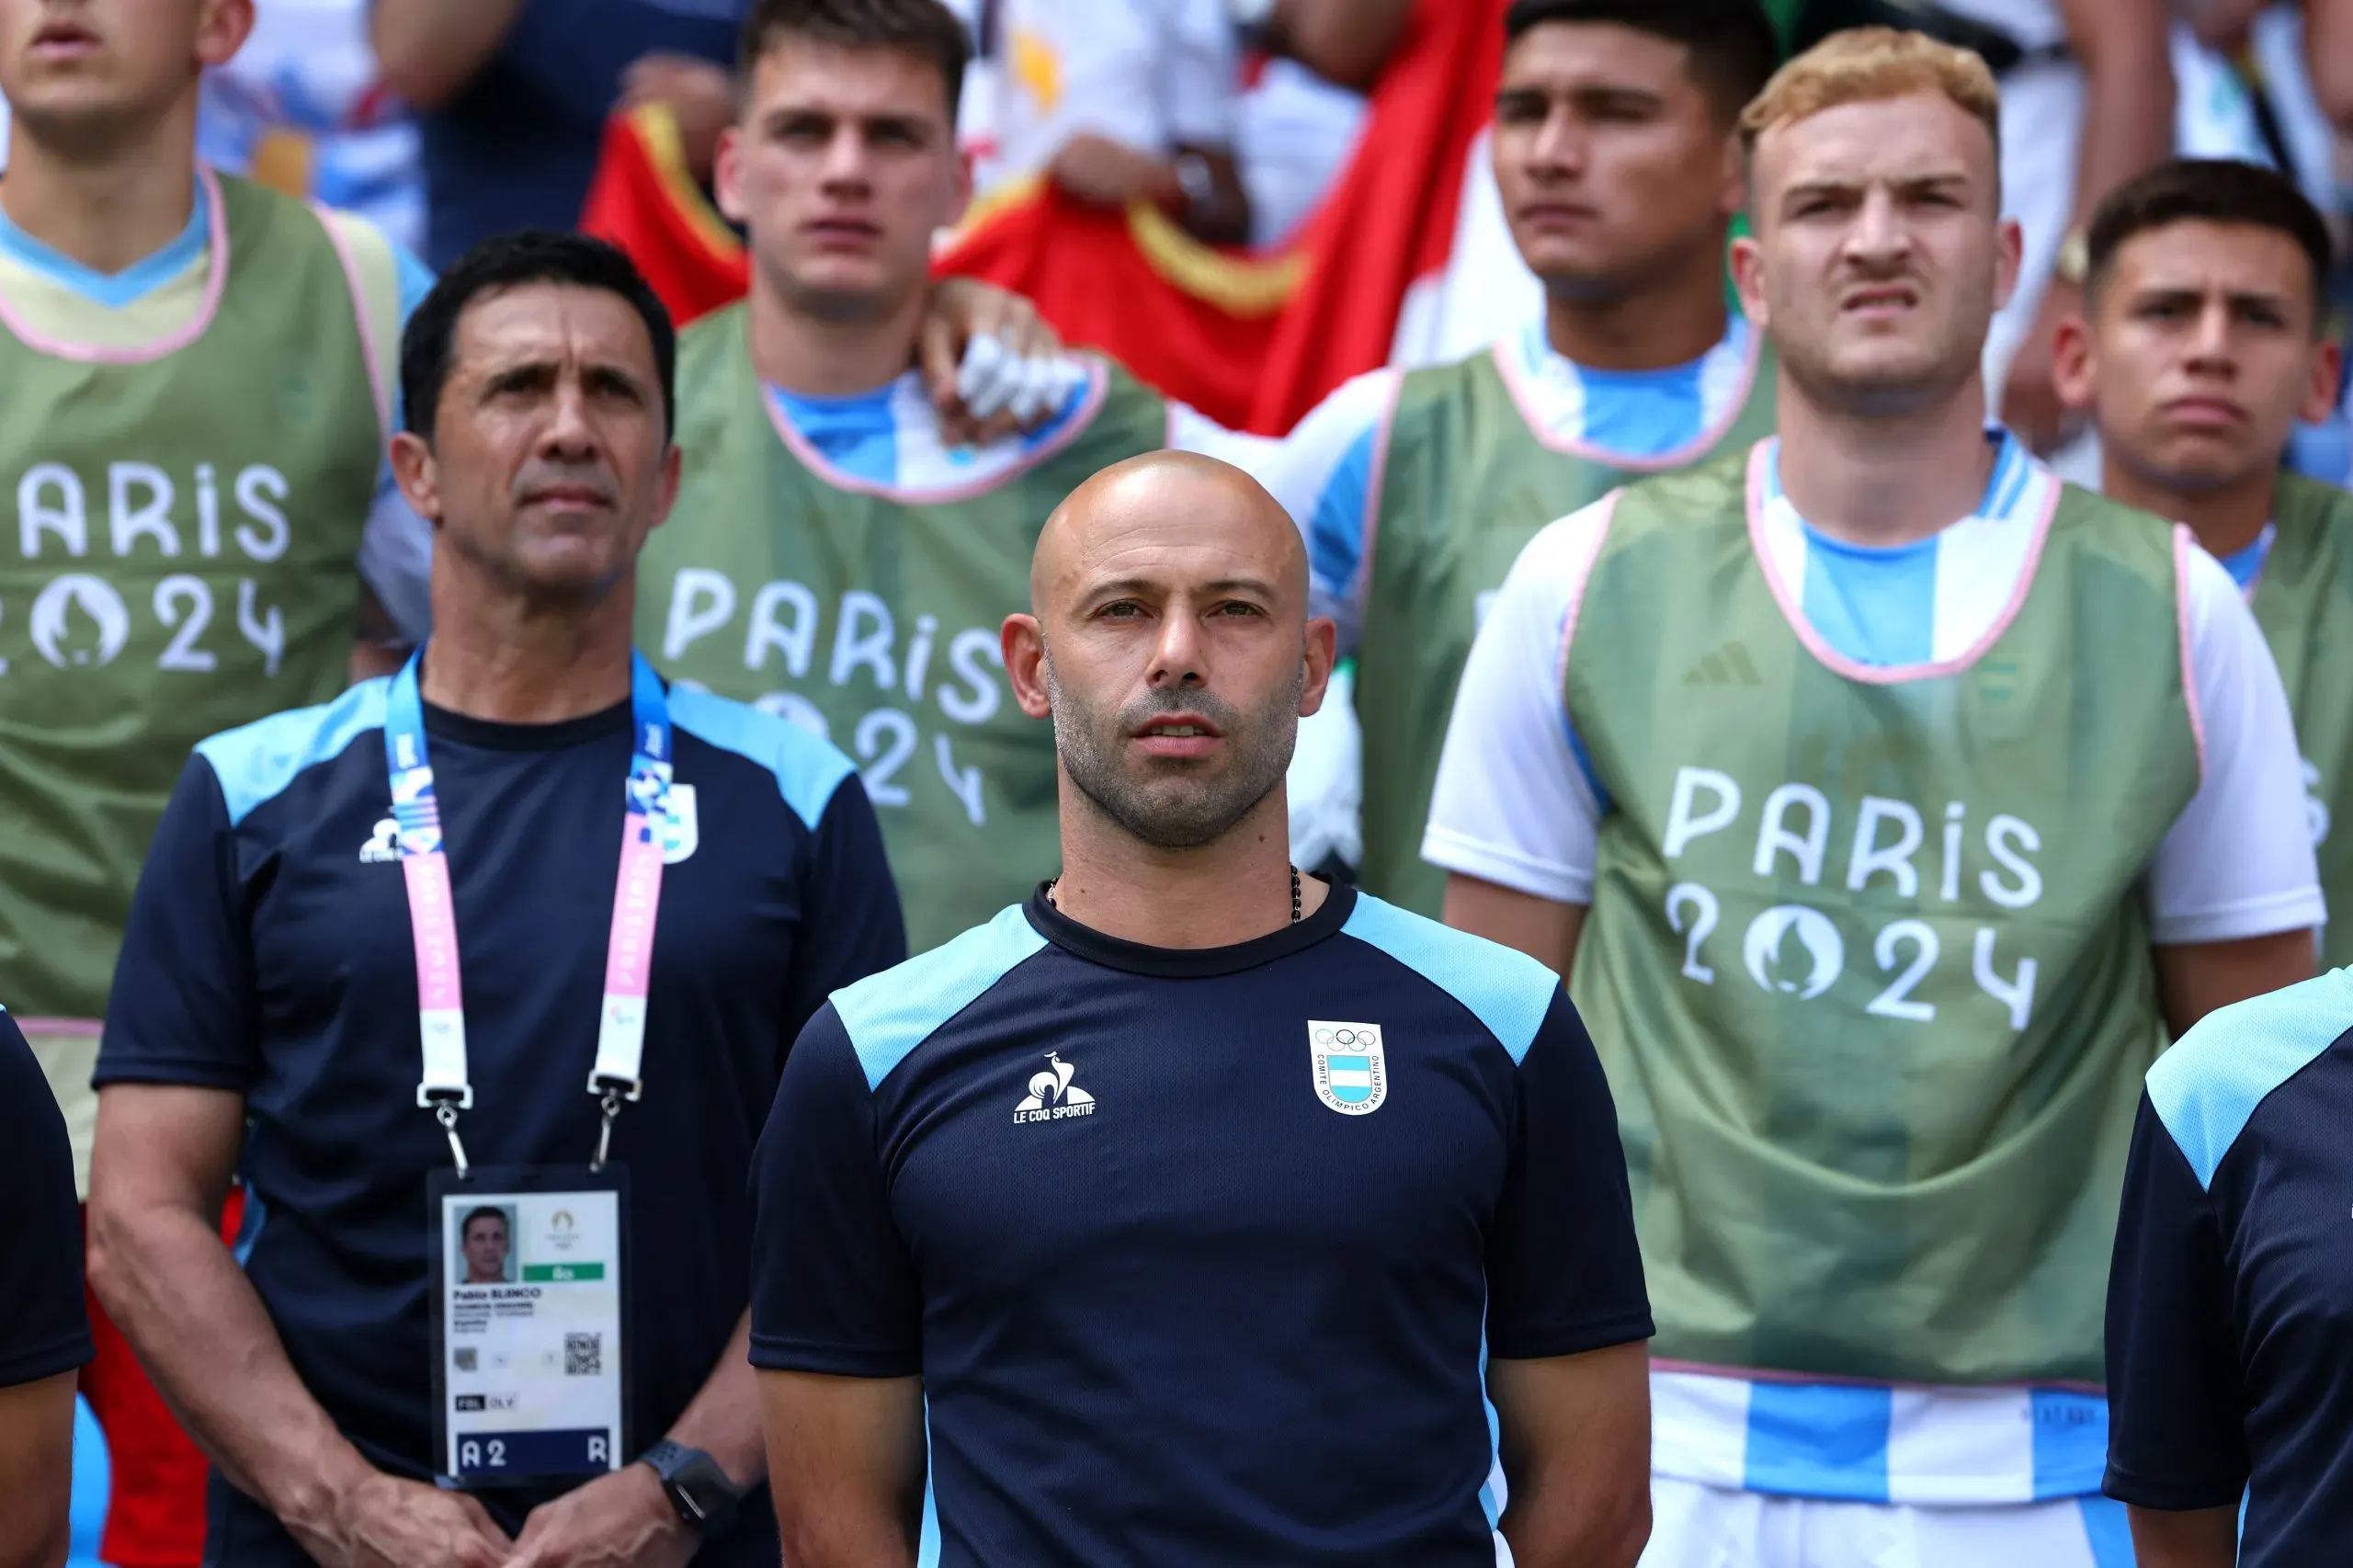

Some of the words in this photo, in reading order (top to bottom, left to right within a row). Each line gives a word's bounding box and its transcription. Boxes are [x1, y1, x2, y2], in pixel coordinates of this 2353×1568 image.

[0, 460, 290, 563] ARiS
[0, 572, 286, 678] 024
[1665, 881, 2037, 1031] 2024
[1014, 1111, 1027, 1124] LE
[1029, 1108, 1051, 1122] COQ
[1052, 1102, 1096, 1119] SPORTIF
[1317, 1053, 1327, 1085] COMITE
[1322, 1089, 1370, 1111] OLIMPICO
[1370, 1055, 1382, 1105] ARGENTINO
[461, 1439, 481, 1468] A
[486, 1438, 506, 1467] 2
[586, 1435, 608, 1462] R
